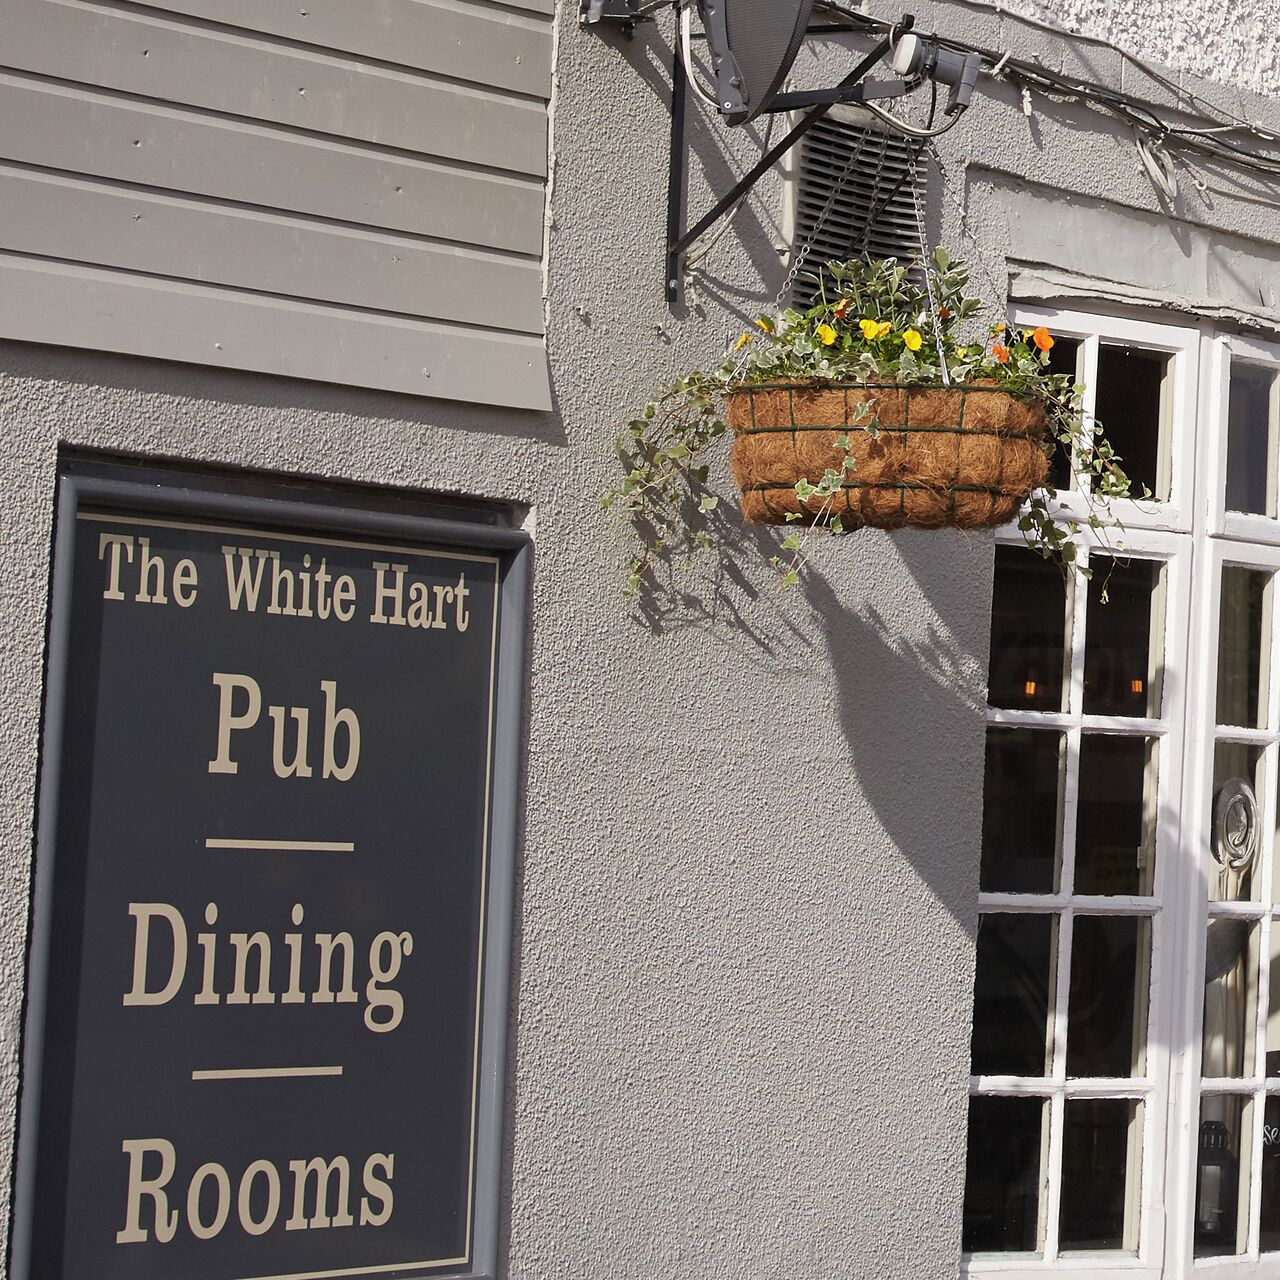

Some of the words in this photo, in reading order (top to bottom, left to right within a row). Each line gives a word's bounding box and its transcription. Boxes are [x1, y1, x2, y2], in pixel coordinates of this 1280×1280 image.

[98, 533, 199, 608] The
[221, 545, 356, 622] White
[370, 561, 470, 632] Hart
[208, 672, 362, 782] Pub
[123, 902, 413, 1033] Dining
[116, 1138, 395, 1244] Rooms
